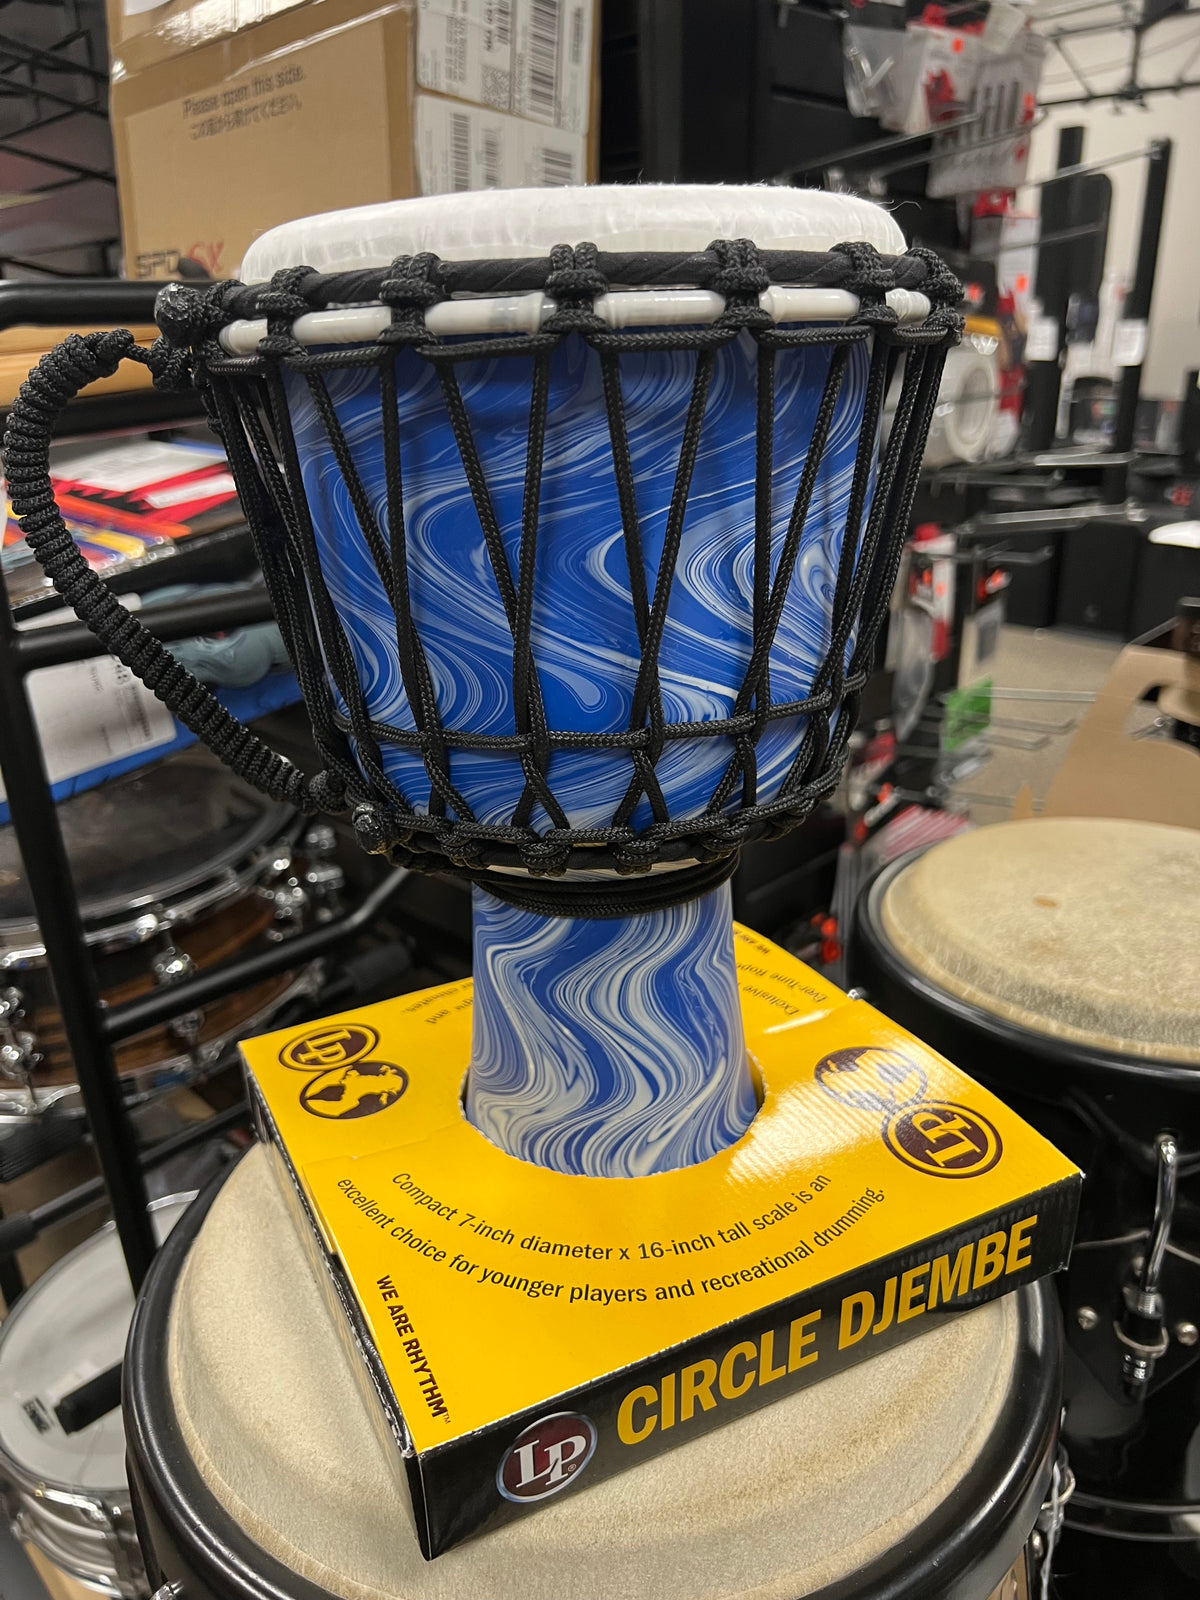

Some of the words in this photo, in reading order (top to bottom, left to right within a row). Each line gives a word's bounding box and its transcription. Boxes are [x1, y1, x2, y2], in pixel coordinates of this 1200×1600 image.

[337, 1179, 394, 1229] excellent
[390, 1228, 447, 1262] choice
[449, 1254, 480, 1276] for
[477, 1267, 564, 1298] younger
[569, 1284, 648, 1306] players
[655, 1279, 695, 1301] and
[701, 1240, 814, 1293] recreational
[813, 1187, 885, 1247] drumming.
[392, 1173, 458, 1221] Compact
[459, 1213, 515, 1245] 7-inch
[520, 1235, 613, 1260] diameter
[619, 1247, 631, 1260] x
[638, 1234, 716, 1260] 16-inch
[717, 1221, 752, 1244] tall
[752, 1203, 798, 1231] scale
[791, 1192, 813, 1204] is
[809, 1174, 832, 1193] an
[376, 1274, 399, 1302] WE
[387, 1304, 415, 1337] ARE
[616, 1310, 822, 1446] CIRCLE
[838, 1214, 1039, 1350] DJEMBE
